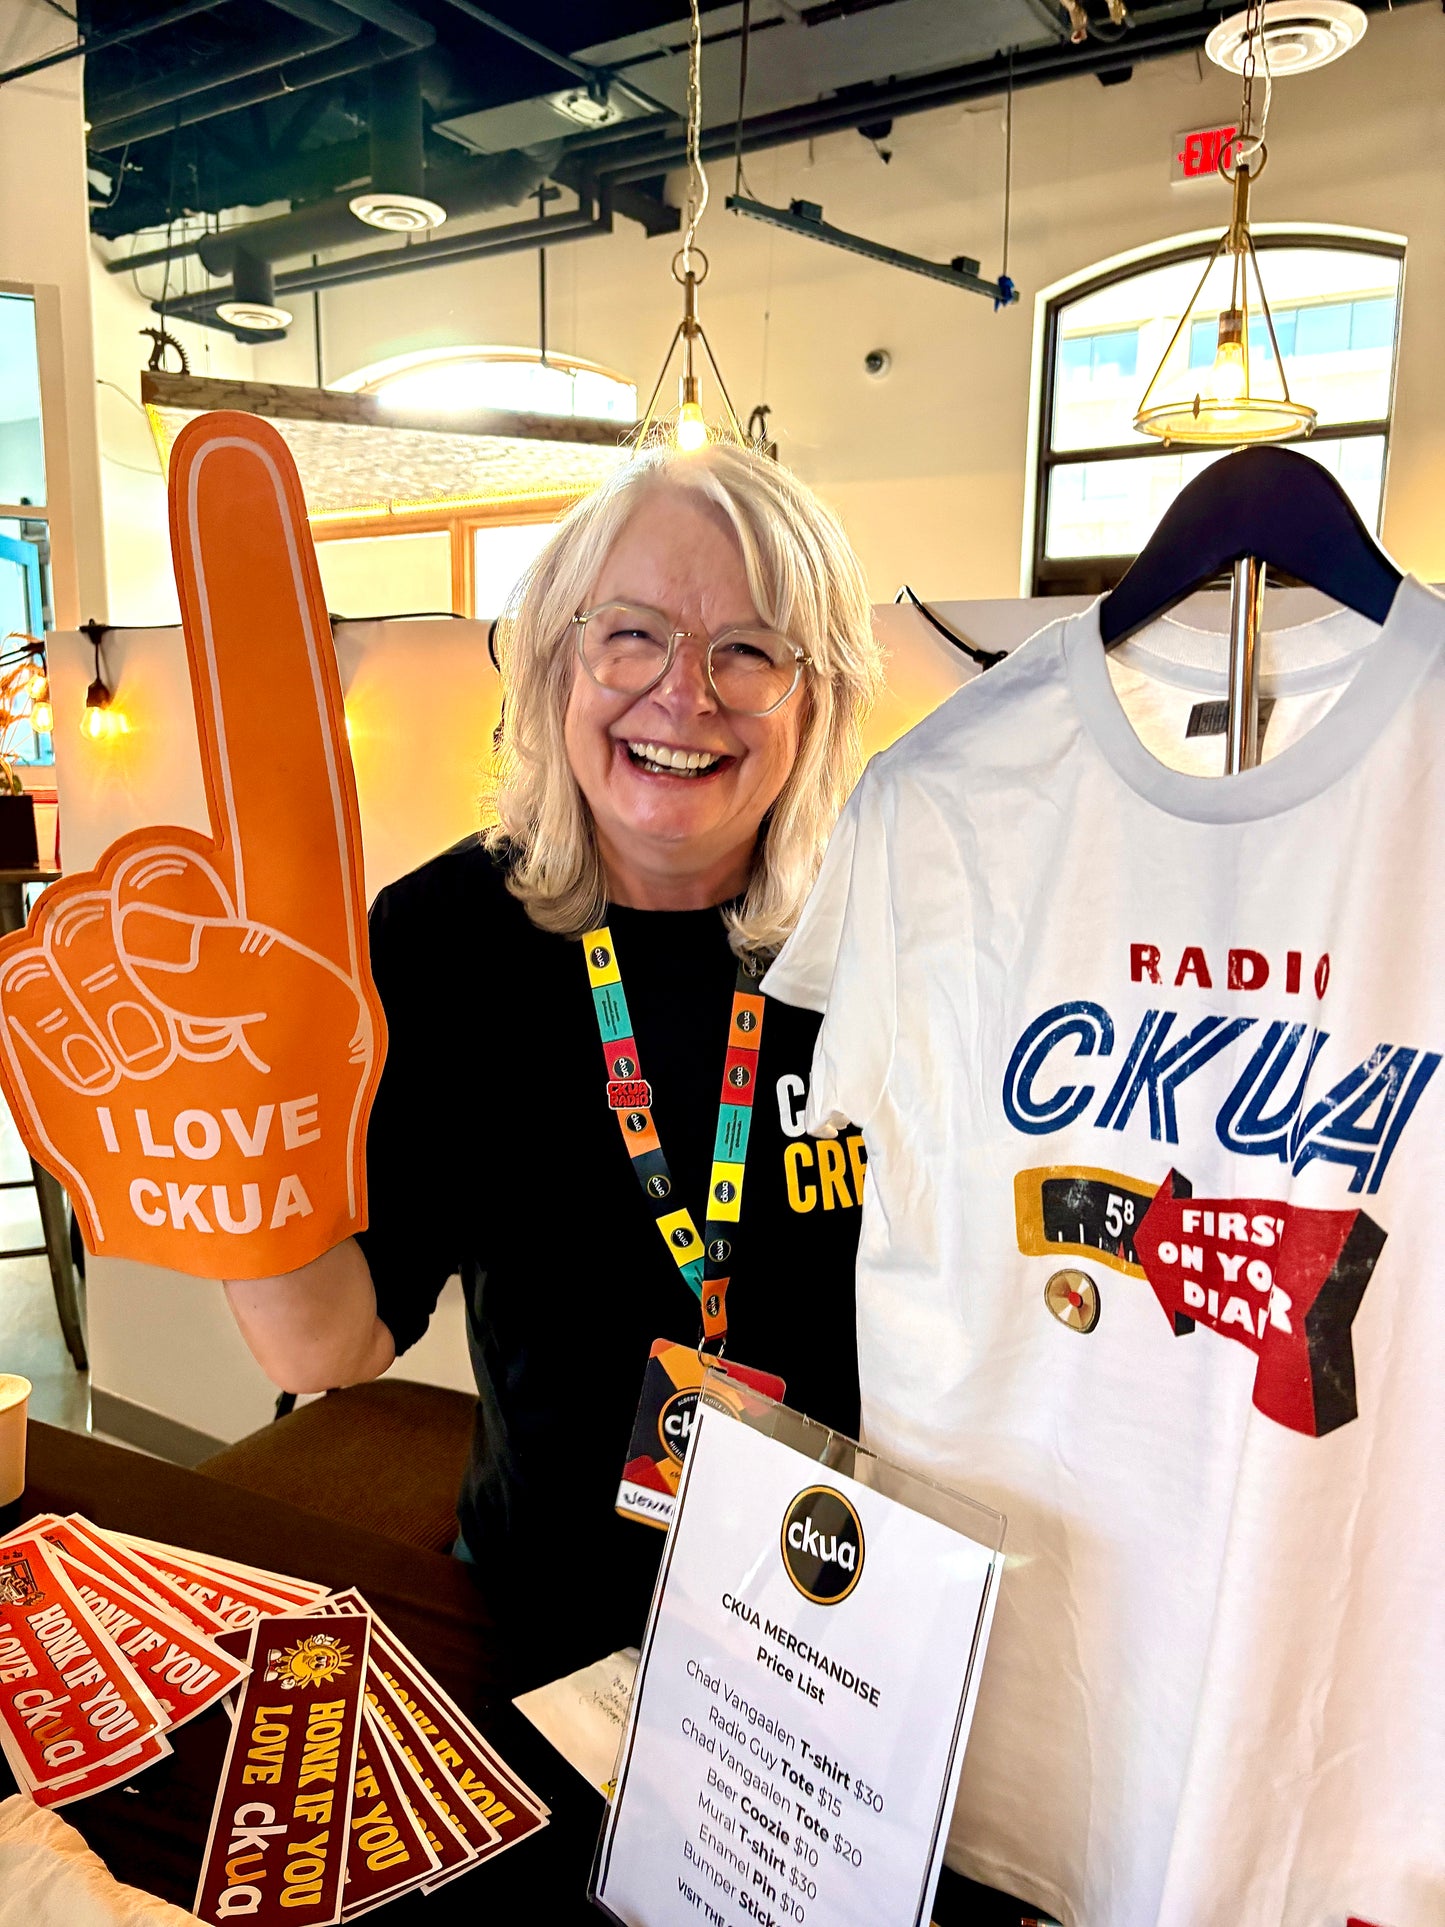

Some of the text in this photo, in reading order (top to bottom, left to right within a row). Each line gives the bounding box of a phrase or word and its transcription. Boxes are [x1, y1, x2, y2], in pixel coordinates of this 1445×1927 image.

[1184, 127, 1237, 177] EXIT
[1130, 943, 1330, 1000] RADIO
[608, 1082, 649, 1096] CKUA
[610, 1094, 648, 1106] RADIO
[1002, 1000, 1444, 1194] CKUA
[96, 1093, 322, 1160] I LOVE
[129, 1174, 314, 1234] CKUA
[784, 1136, 868, 1213] CRE
[1104, 1193, 1135, 1238] 58
[1158, 1241, 1292, 1334] ON YOR
[788, 1516, 856, 1572] ckua
[26, 1603, 92, 1671] HONK
[214, 1594, 258, 1628] YO
[61, 1658, 107, 1690] IF
[121, 1626, 167, 1658] IF
[150, 1643, 221, 1696] YOU
[721, 1593, 881, 1708] CKUA MERCHANDISE
[756, 1645, 825, 1704] Price List
[13, 1689, 86, 1767] ckua
[79, 1681, 140, 1742] YOU
[686, 1659, 884, 1813] Chad Vangaalen T-shirt $30
[681, 1717, 862, 1867] Chad Vangaalen Tote $20
[709, 1705, 842, 1817] Radio Guy Tote $15
[215, 1704, 293, 1920] LOVE ckua
[279, 1699, 345, 1908] HONK IF YOU
[352, 1801, 410, 1871] YOU
[707, 1766, 818, 1868] Beer Coozie $10
[698, 1791, 817, 1900] Mural T-shirt $30
[699, 1823, 805, 1924] Enamel Pin $10
[677, 1876, 726, 1927] VISIT THE
[683, 1840, 782, 1927] Bumper Stick
